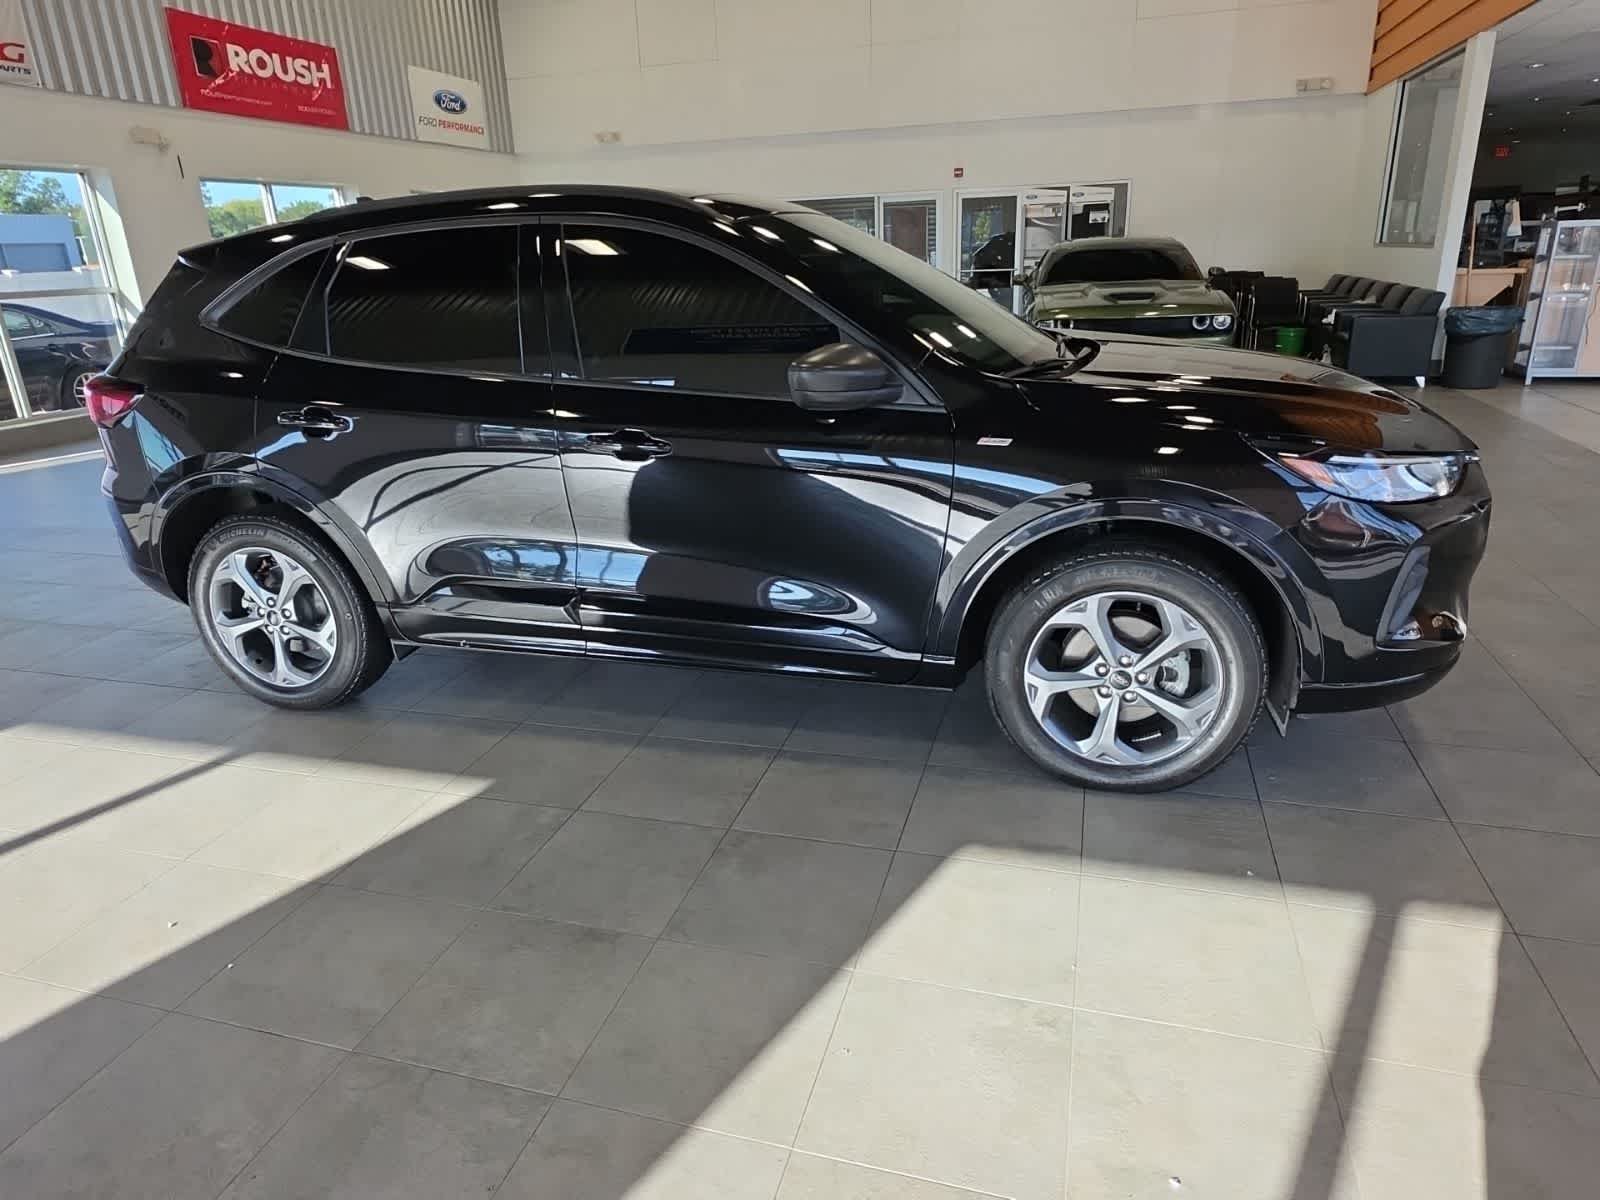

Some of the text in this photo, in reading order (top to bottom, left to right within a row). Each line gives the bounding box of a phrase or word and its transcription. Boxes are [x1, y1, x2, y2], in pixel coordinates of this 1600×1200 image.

[226, 43, 332, 89] ROUSH
[440, 93, 461, 111] Ford
[418, 115, 437, 128] FORD
